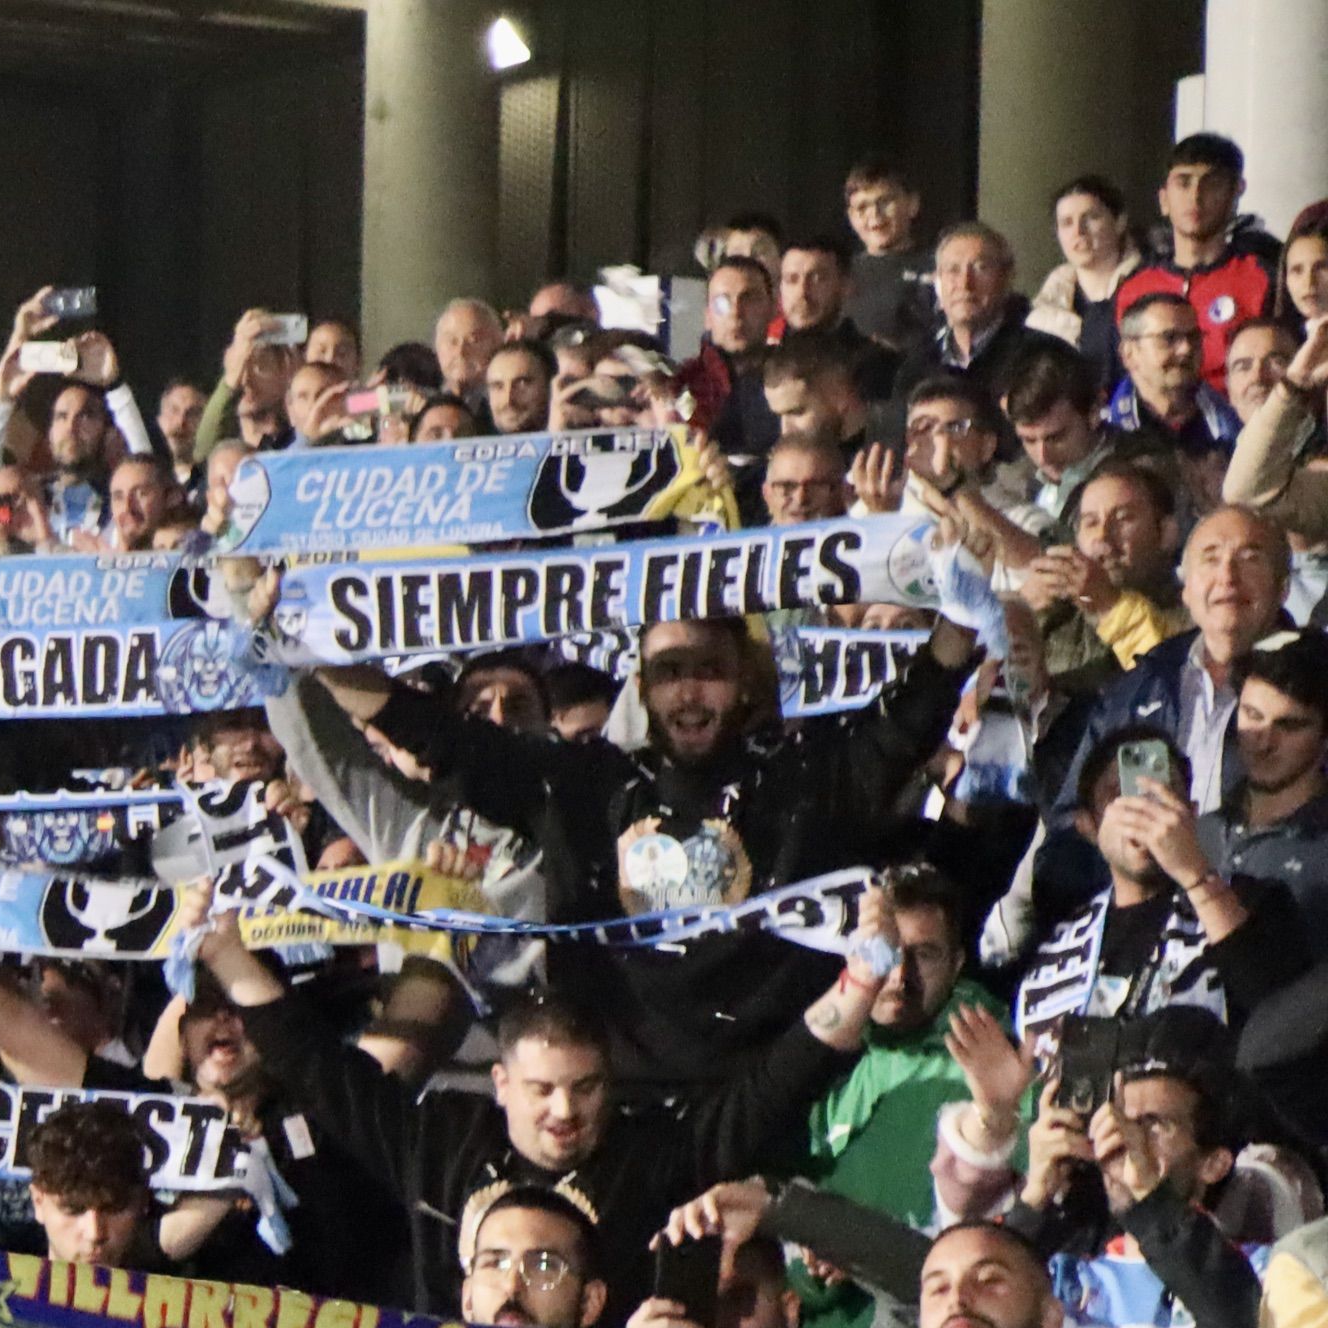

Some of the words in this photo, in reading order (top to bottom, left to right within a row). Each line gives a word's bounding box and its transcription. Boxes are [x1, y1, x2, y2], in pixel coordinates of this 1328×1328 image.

[295, 465, 445, 504] CIUDAD
[454, 459, 514, 495] DE
[311, 494, 472, 531] LUCENA
[101, 570, 149, 598] DE
[331, 558, 628, 652] SIEMPRE
[643, 530, 862, 620] FIELES
